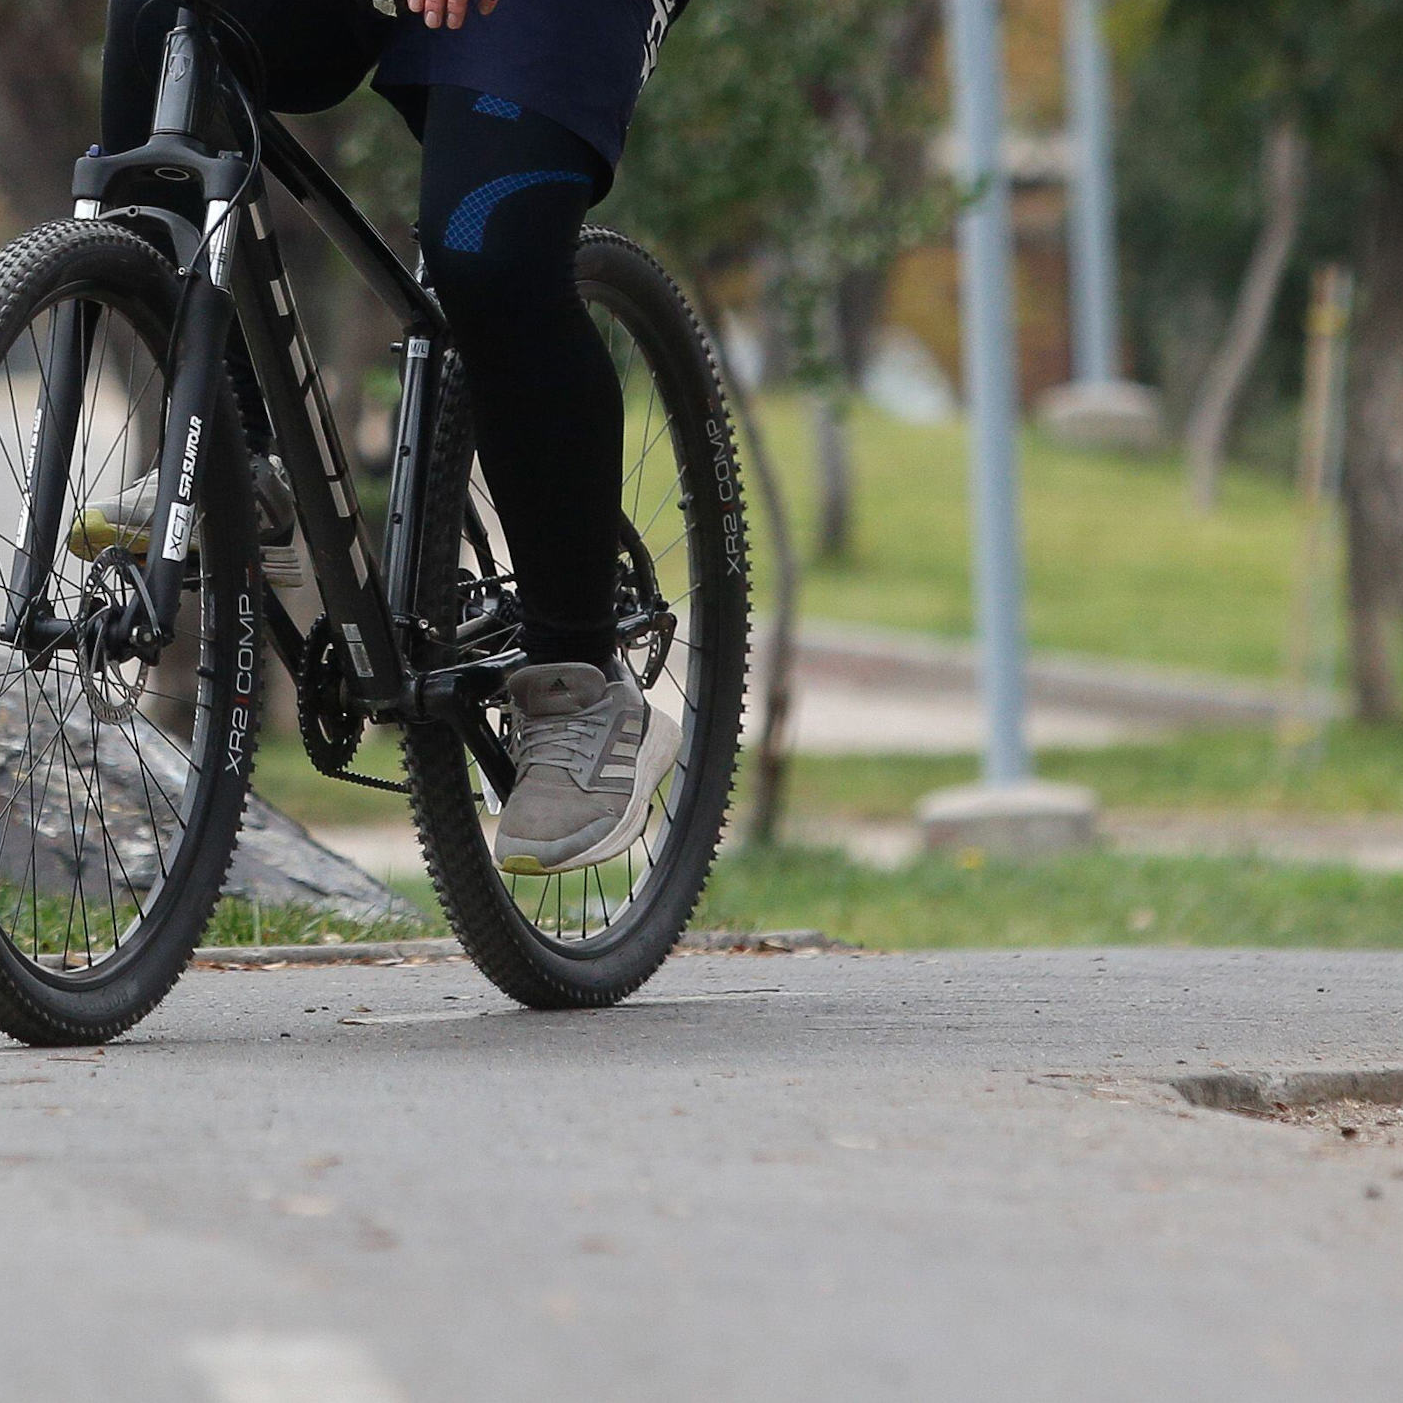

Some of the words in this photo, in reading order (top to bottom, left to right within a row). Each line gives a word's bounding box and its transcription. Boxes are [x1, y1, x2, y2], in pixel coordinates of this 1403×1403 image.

[706, 419, 734, 502] COMP
[723, 512, 741, 576] XR2
[236, 594, 254, 694] COMP
[225, 707, 248, 776] XR2
